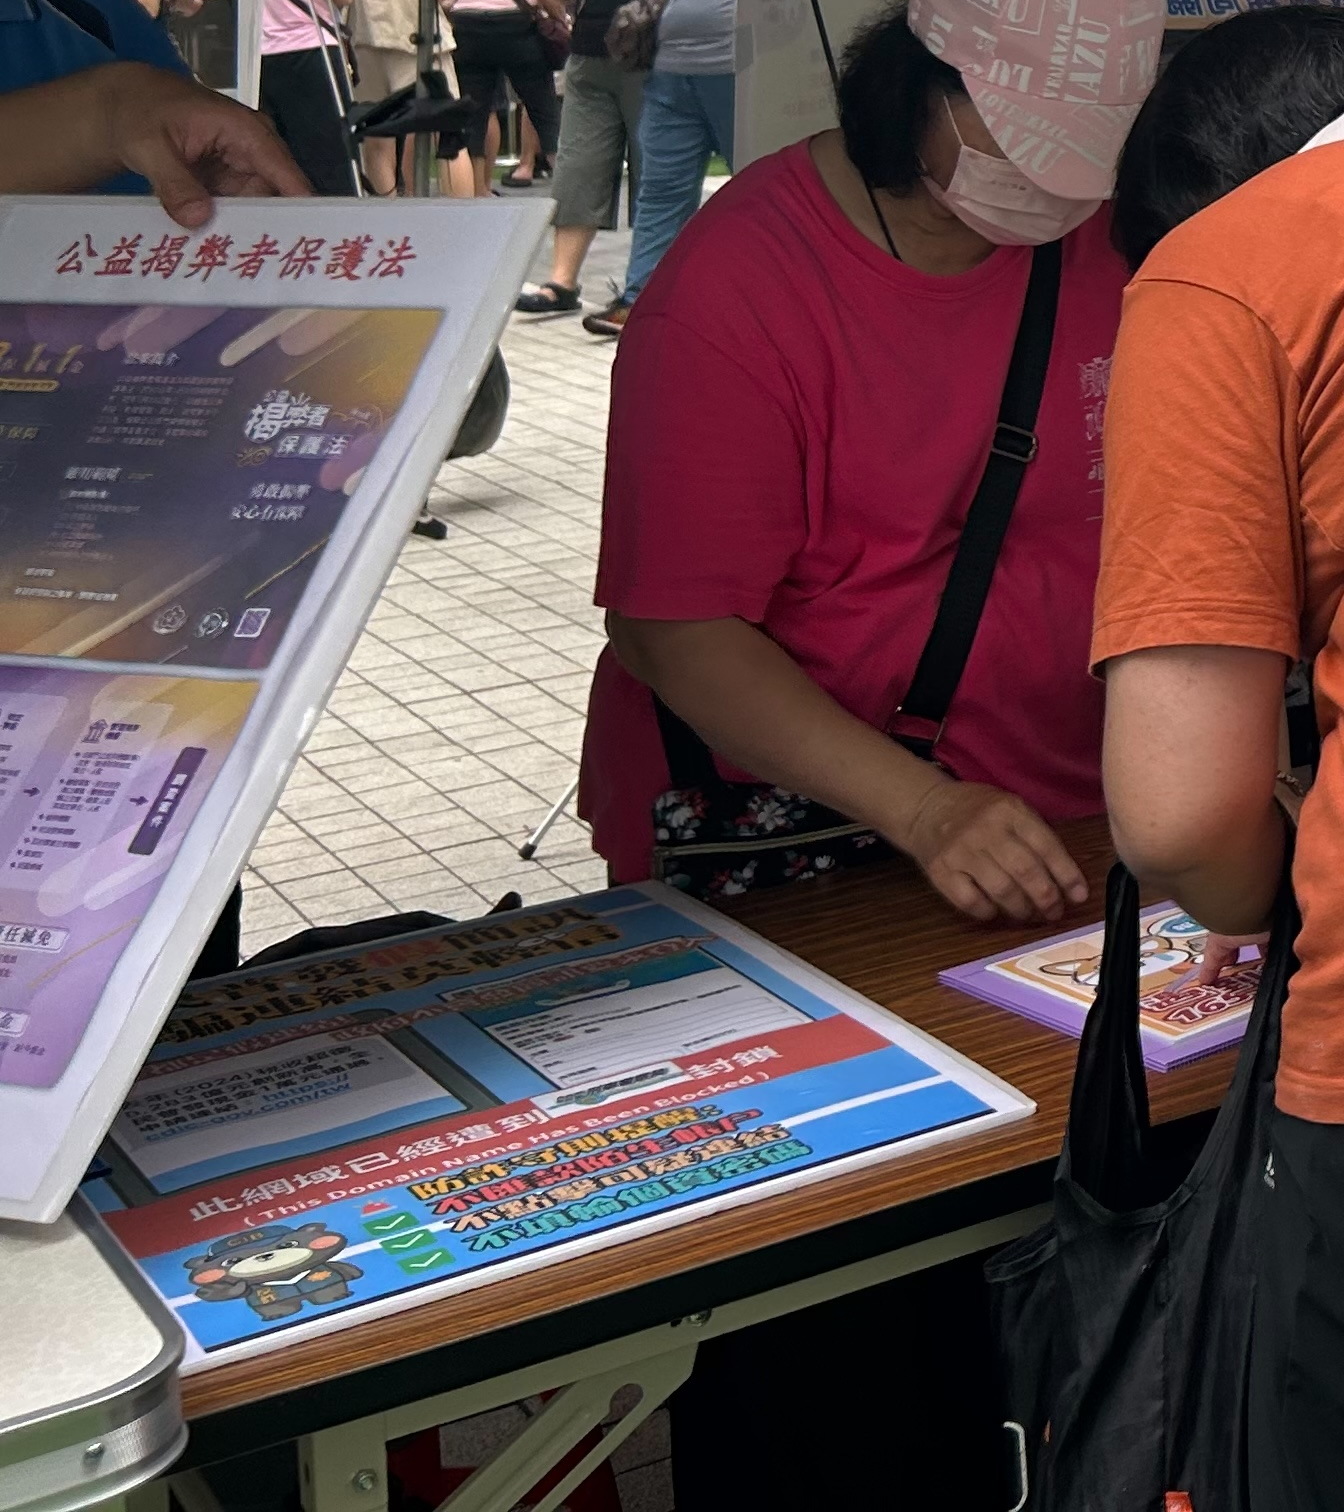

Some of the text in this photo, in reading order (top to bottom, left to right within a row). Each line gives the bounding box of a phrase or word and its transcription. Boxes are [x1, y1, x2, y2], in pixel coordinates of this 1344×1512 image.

[56, 232, 417, 282] 公益揭弊者保護法
[184, 1042, 786, 1225] 此網域已經遭到 封鎖
[325, 1162, 439, 1204] Domain
[440, 1138, 527, 1170] Name
[581, 1102, 653, 1130] Been
